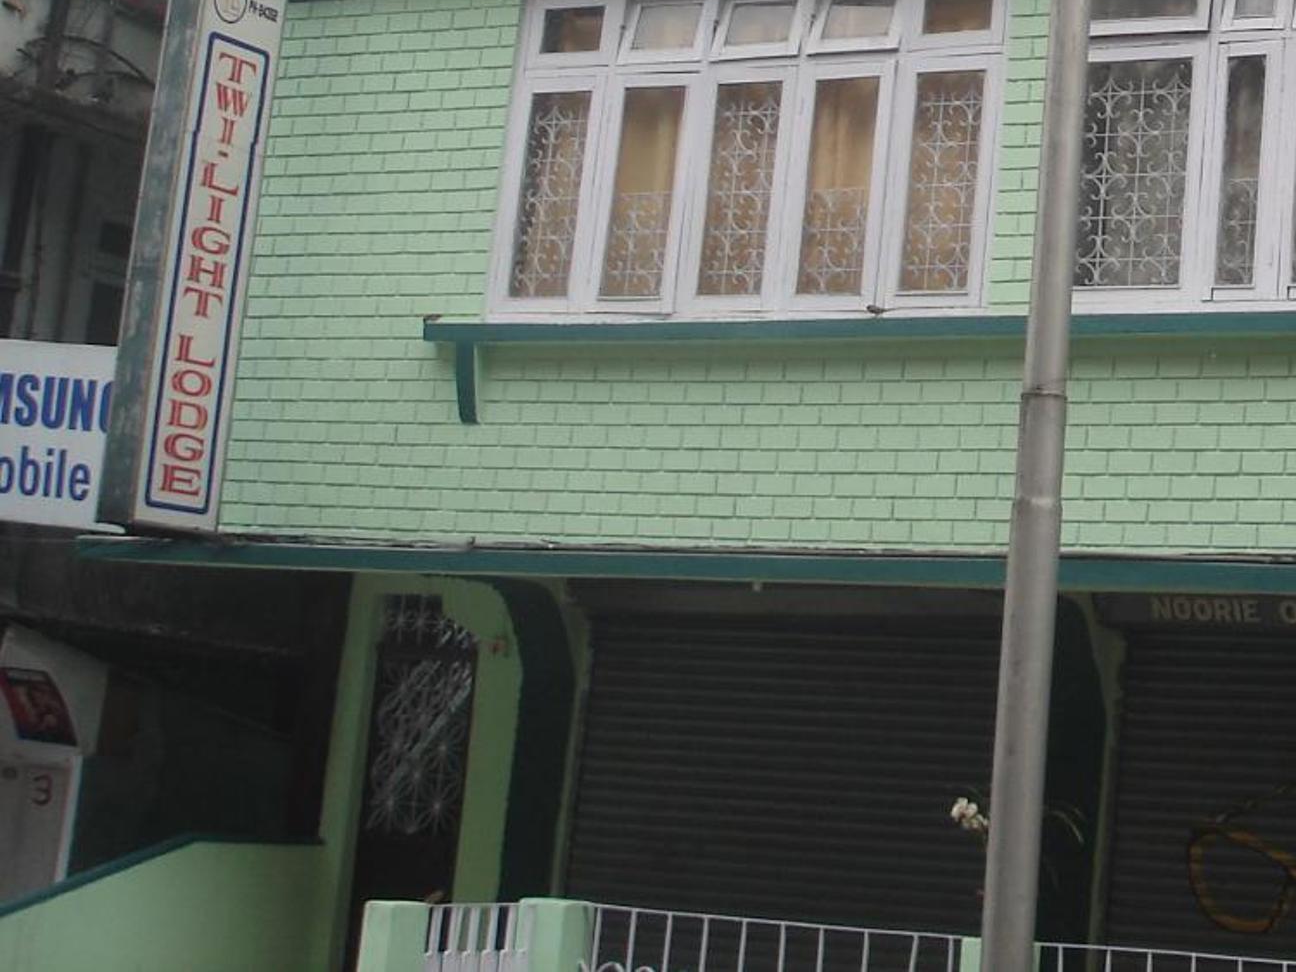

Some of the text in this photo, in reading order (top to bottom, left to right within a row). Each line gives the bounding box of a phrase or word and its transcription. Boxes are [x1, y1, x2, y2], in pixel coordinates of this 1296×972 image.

[160, 52, 257, 498] TWI-LIGHT LODGE
[1150, 595, 1261, 624] NOORIE
